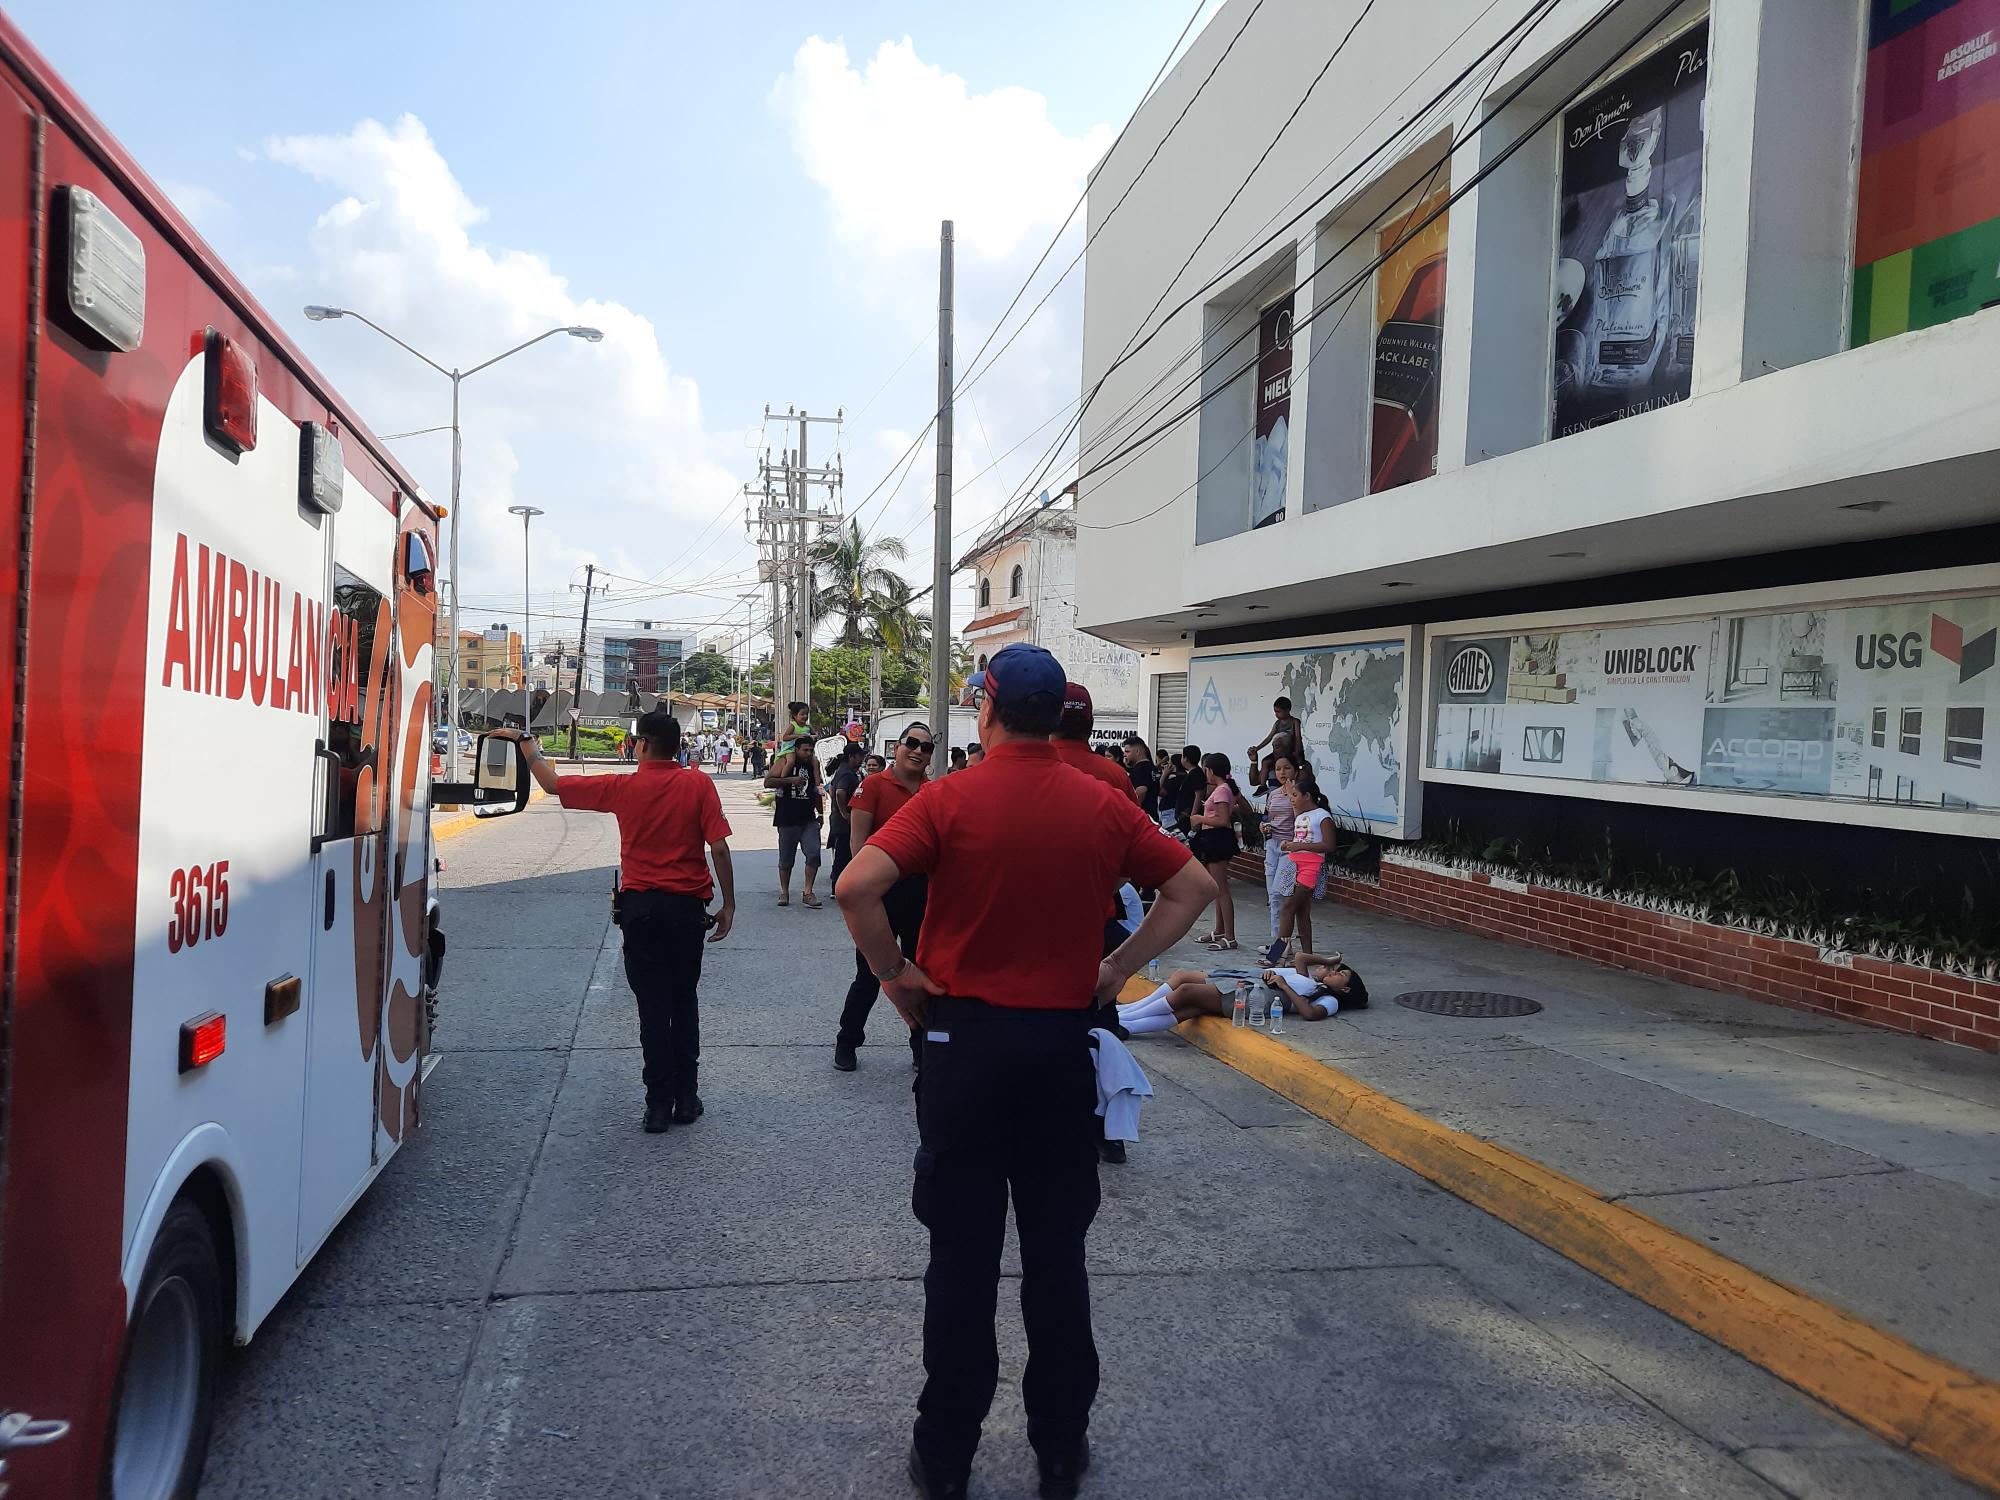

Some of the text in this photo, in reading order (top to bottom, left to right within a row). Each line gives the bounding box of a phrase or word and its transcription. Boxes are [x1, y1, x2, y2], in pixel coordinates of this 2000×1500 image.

[1942, 30, 1993, 67] ABSOLUT
[1569, 127, 1593, 149] Don
[1376, 351, 1433, 369] ACK LABE
[1378, 336, 1438, 352] JOHNNIE WALKER
[1562, 391, 1680, 437] ESENC RISTALINA
[161, 532, 360, 725] AMBULANCIA
[1604, 644, 1697, 675] UNIBLOCK
[1855, 631, 1922, 670] USG
[1449, 649, 1491, 692] ARDEX
[1091, 730, 1137, 740] TACIONAM
[1707, 738, 1824, 760] ACCORD
[167, 860, 231, 955] 3615
